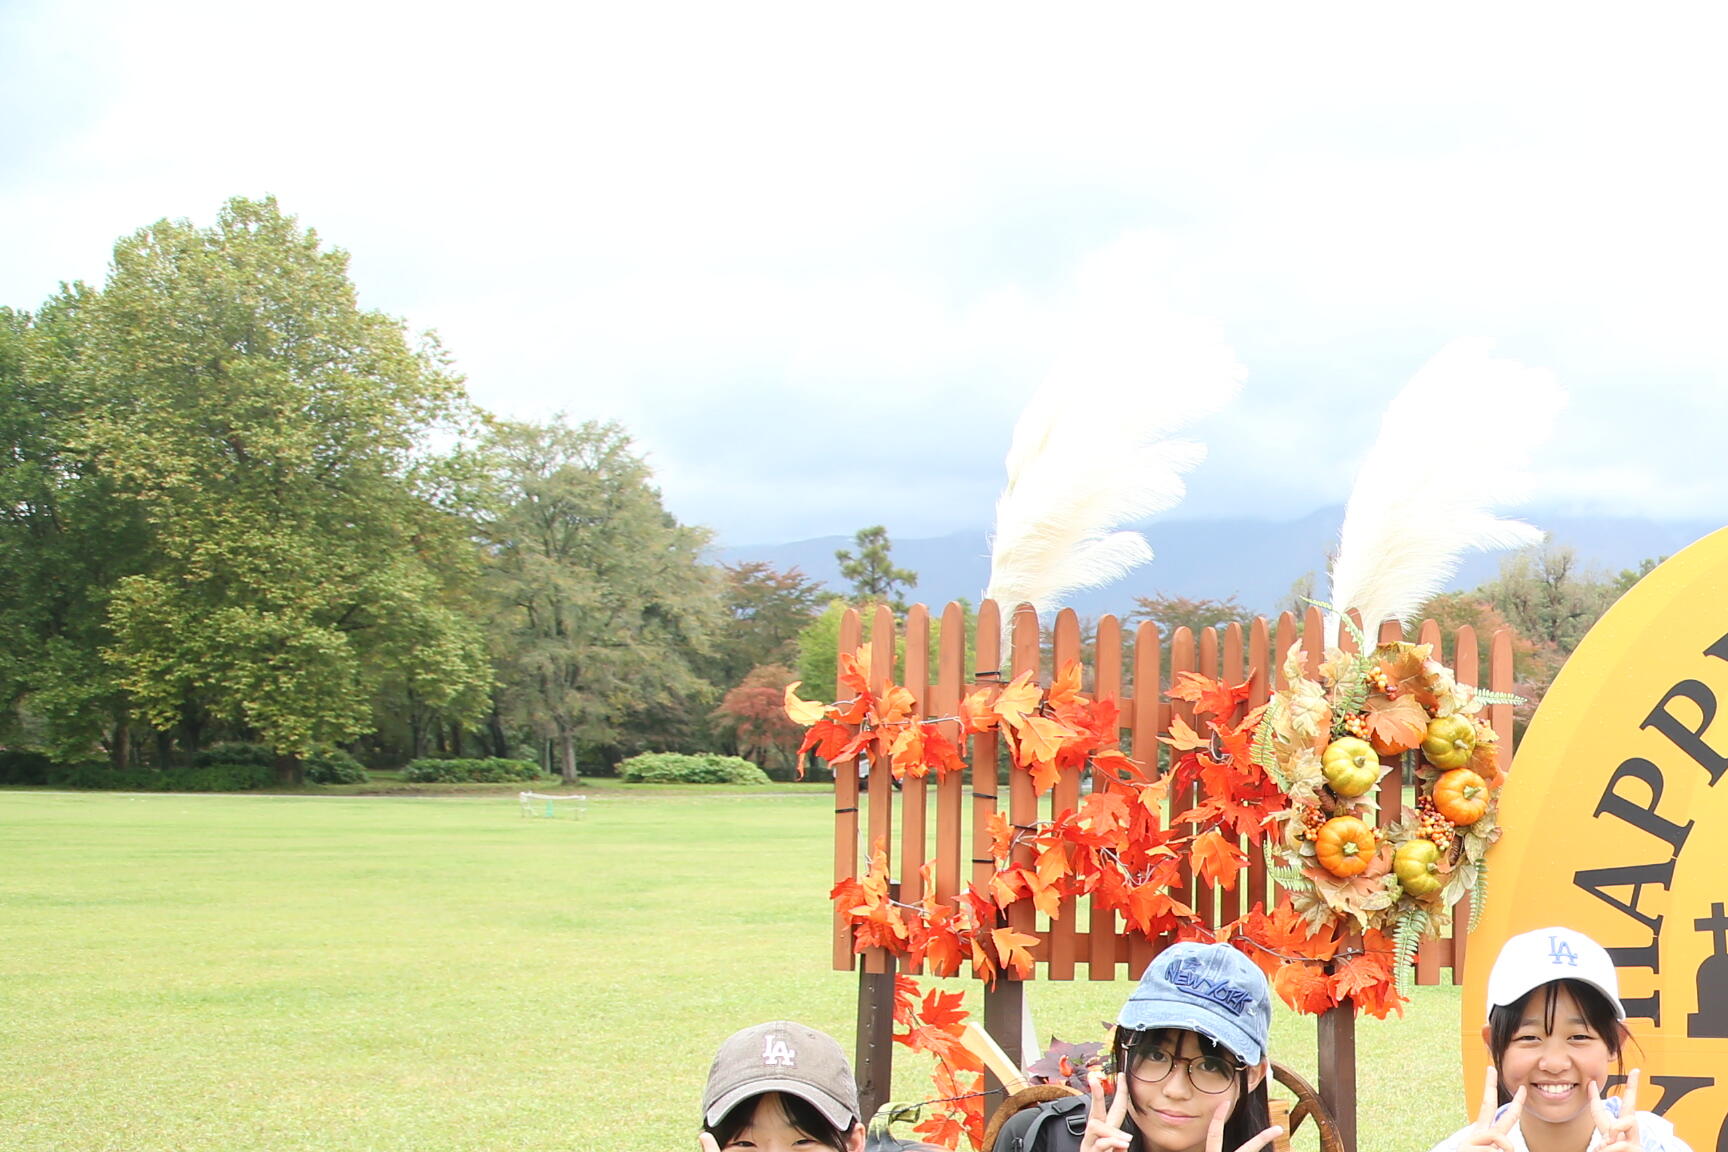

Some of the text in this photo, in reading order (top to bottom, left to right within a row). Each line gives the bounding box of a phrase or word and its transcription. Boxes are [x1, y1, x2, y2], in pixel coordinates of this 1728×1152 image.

[1548, 935, 1578, 967] LA
[1165, 959, 1253, 1014] NEW YORK
[762, 1034, 796, 1066] LA
